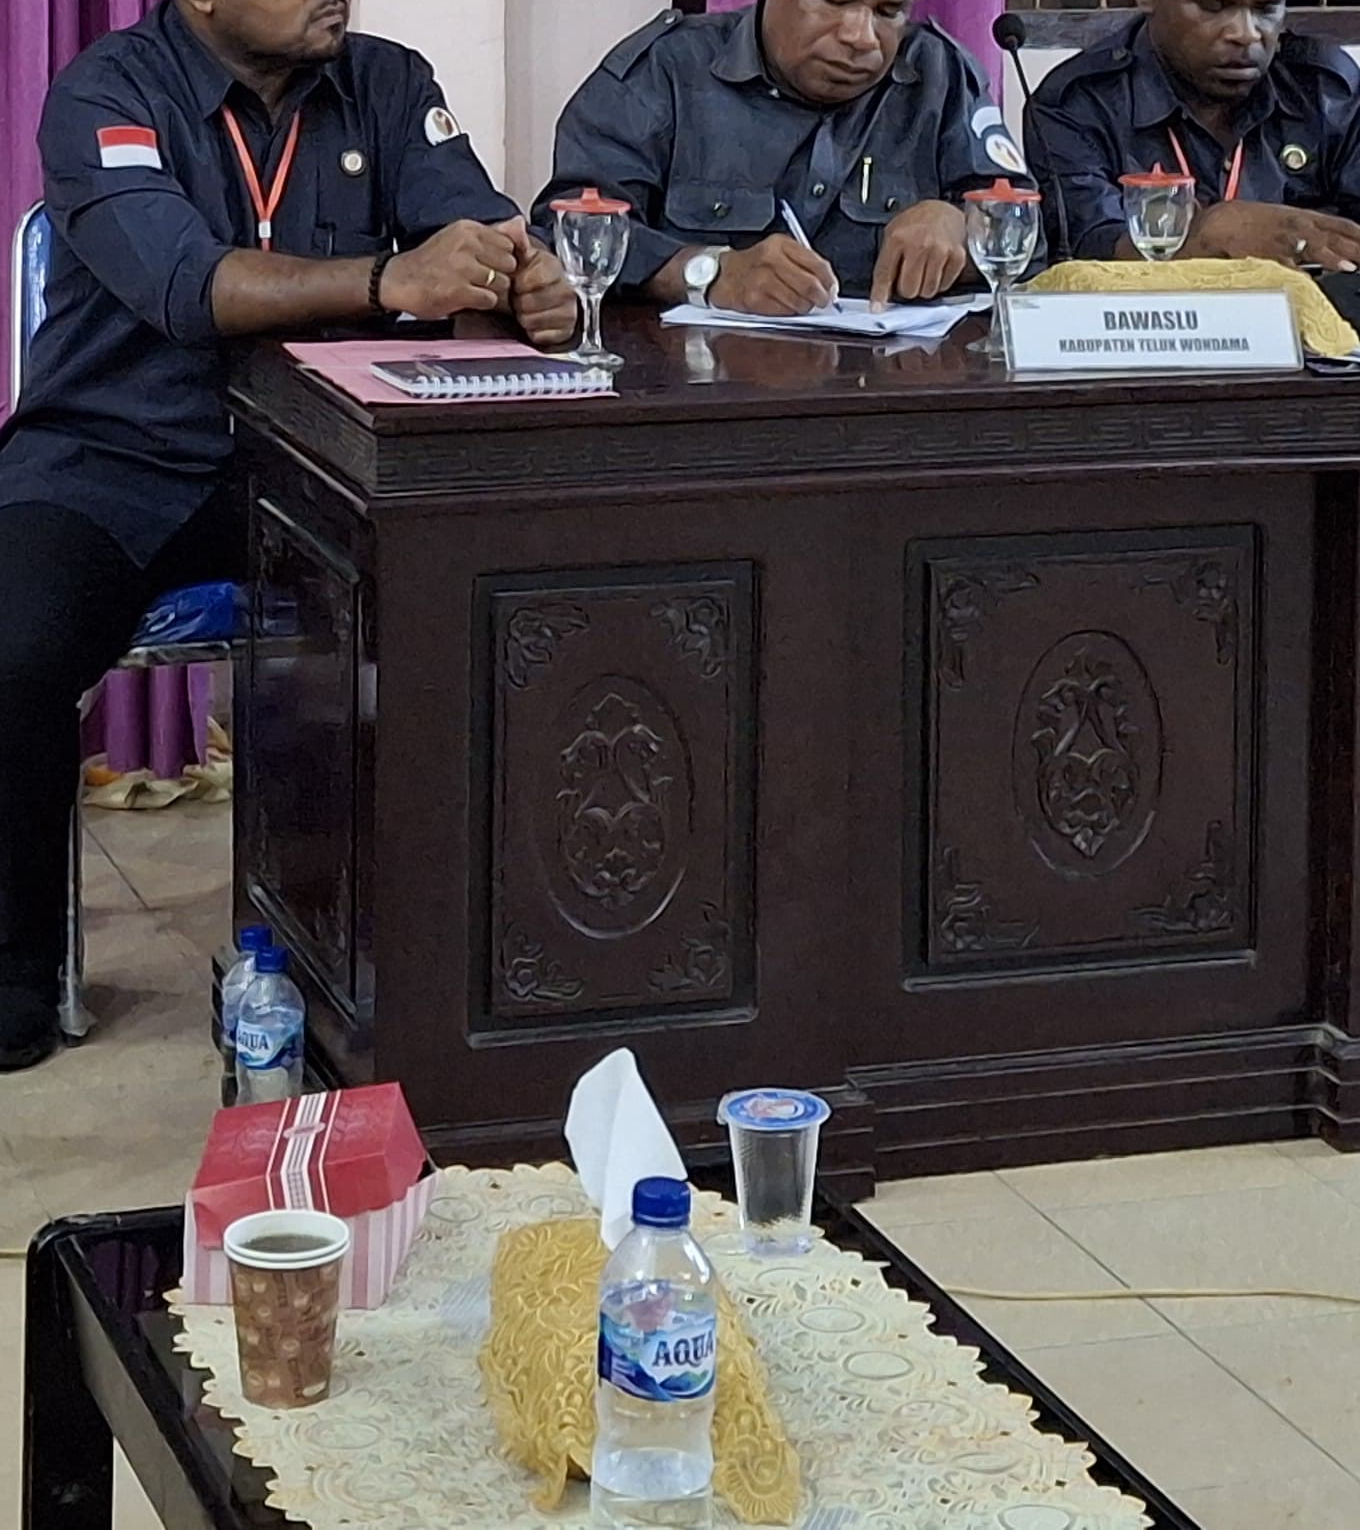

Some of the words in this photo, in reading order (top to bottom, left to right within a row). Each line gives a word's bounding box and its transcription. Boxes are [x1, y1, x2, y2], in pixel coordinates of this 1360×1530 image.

[1103, 309, 1199, 331] BAWASLU
[1058, 337, 1136, 353] KABUPATEN
[1138, 337, 1177, 353] TELUK
[1179, 336, 1250, 352] WONDAMA
[651, 1330, 714, 1368] AQUA
